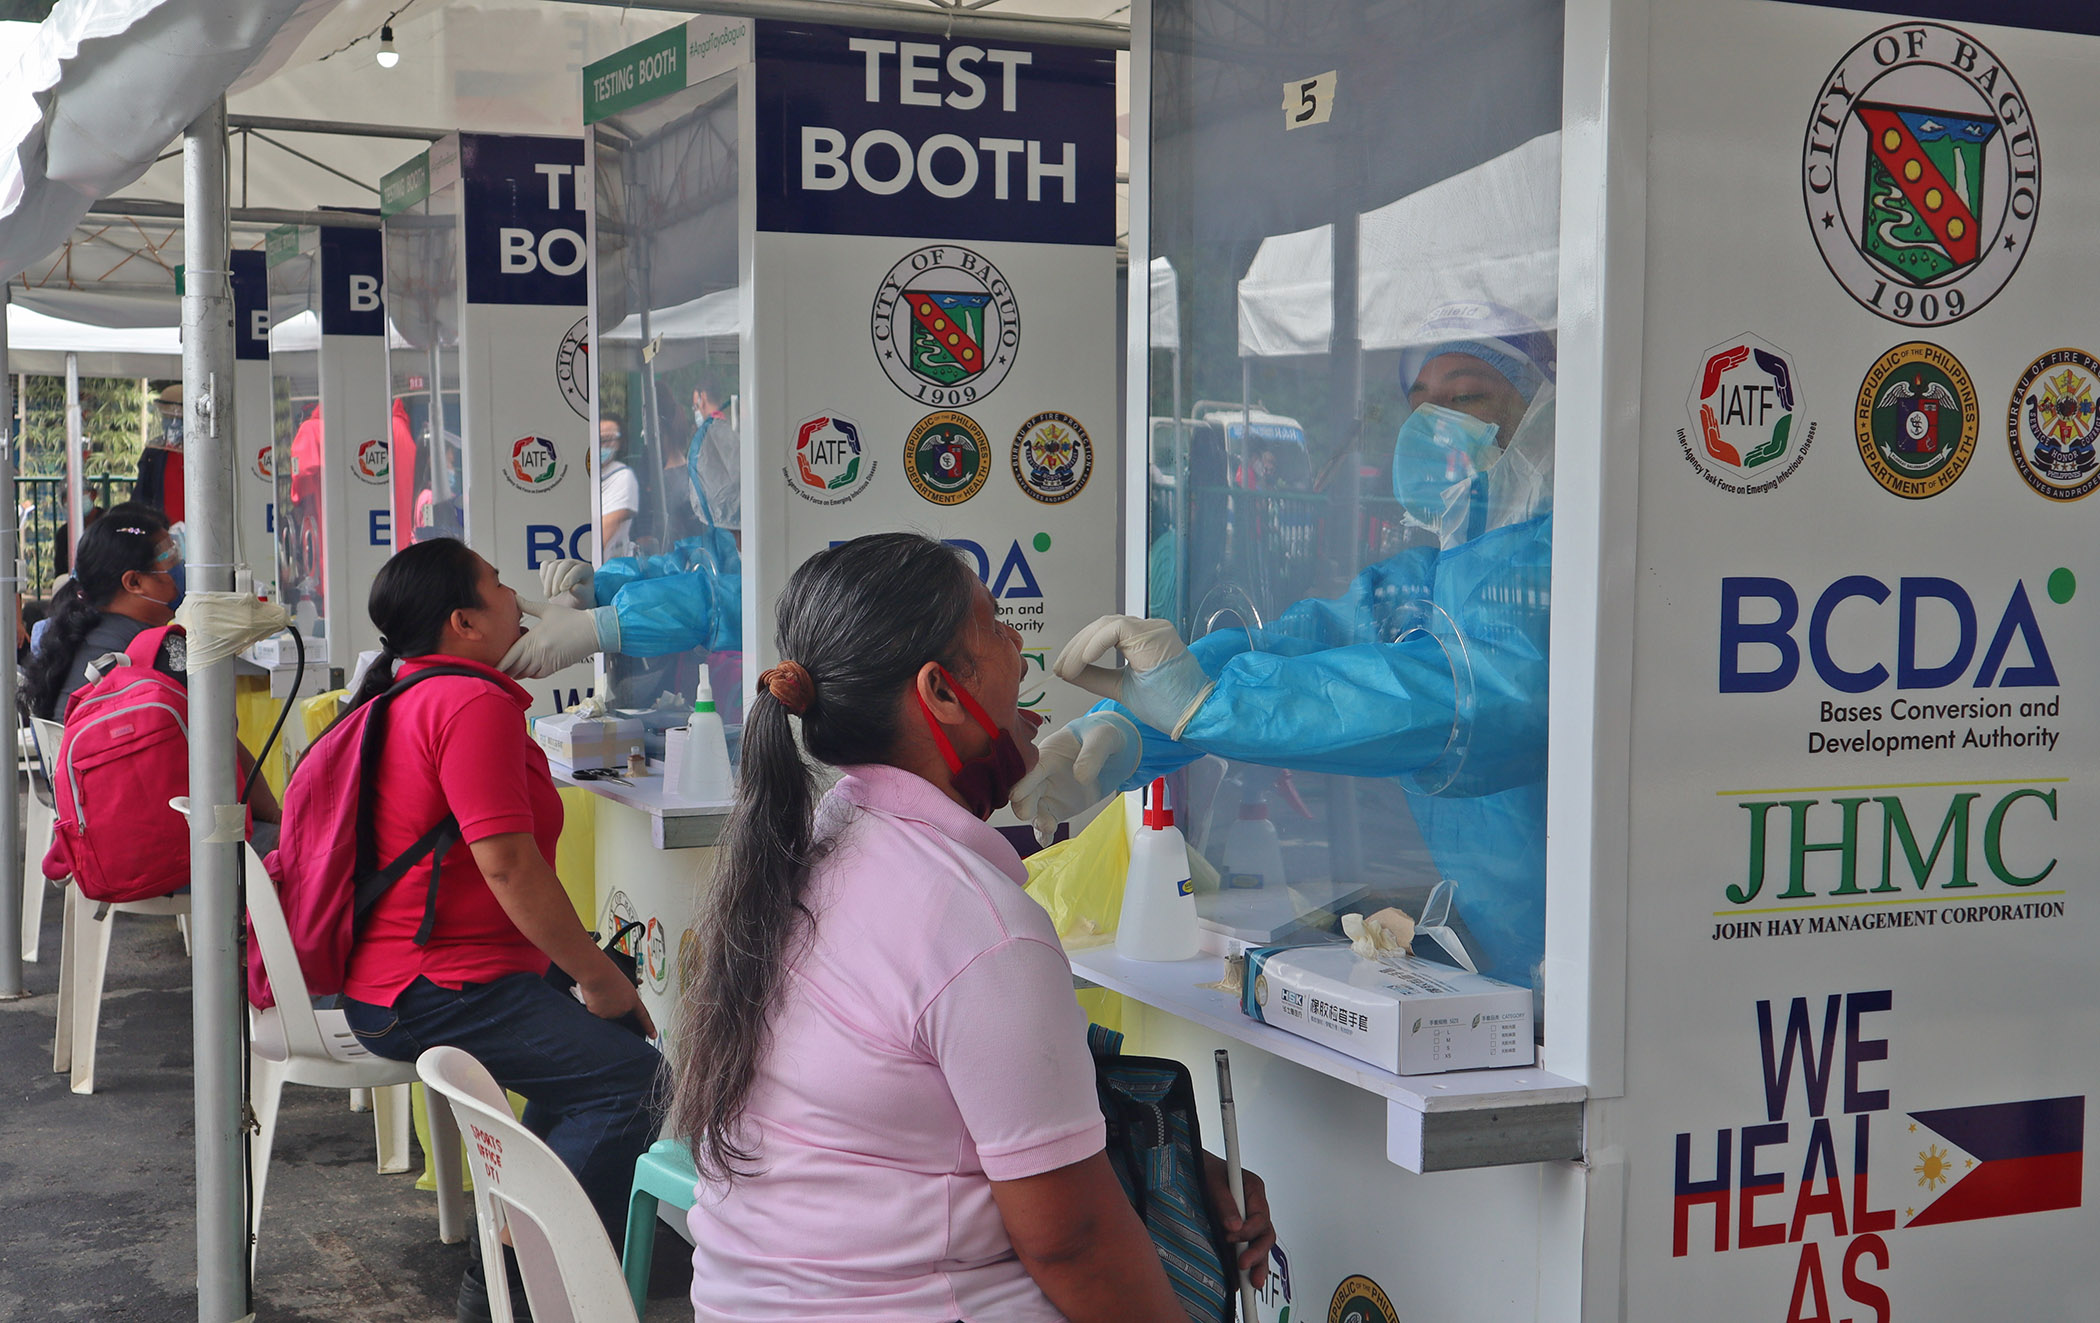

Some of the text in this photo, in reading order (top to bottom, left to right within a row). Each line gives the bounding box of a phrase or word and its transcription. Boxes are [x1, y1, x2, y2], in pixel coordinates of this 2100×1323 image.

[593, 46, 677, 103] TESTING BOOTH
[849, 37, 1032, 112] TEST
[1296, 80, 1317, 122] 5
[1809, 28, 2036, 220] CITY OF BAGUIO
[535, 163, 586, 210] T
[801, 126, 1076, 204] BOOTH
[875, 249, 1017, 347] CITY OF BAGUIO
[1866, 279, 1965, 321] 1909
[560, 331, 578, 381] CITY
[915, 383, 977, 405] 1909
[1720, 384, 1774, 426] IATF
[1859, 352, 1901, 419] REPUBLIC
[1901, 350, 1909, 358] OF
[1924, 348, 1975, 423] PHILIPPINES
[2010, 377, 2030, 437] BUREAU
[2032, 359, 2045, 374] OF
[2051, 352, 2078, 364] FIRE
[366, 451, 387, 465] IATF
[521, 451, 547, 468] IATF
[811, 440, 847, 465] IATF
[906, 417, 934, 458] REPUBLIC
[950, 414, 988, 459] PHILIPPINES
[1012, 430, 1026, 467] BUREAU
[1027, 420, 1036, 429] OF
[1040, 413, 1060, 421] FIRE
[1063, 416, 1092, 467] PROTECTION
[1676, 421, 1818, 494] Inter-Agency Task Force on Emerging Infectious Diseases
[2052, 450, 2078, 462] HONOR
[908, 466, 956, 502] DEPARTMENT
[963, 465, 987, 497] HEALTH
[1860, 432, 1973, 494] DEPARTMENT OF HEALTH
[2014, 450, 2029, 474] SAVE
[2028, 475, 2051, 494] LIVES
[1018, 602, 1043, 615] and
[1719, 575, 2060, 694] BCDA
[1820, 695, 2060, 722] Bases Conversion and
[1808, 725, 2060, 756] Development Authority
[1725, 788, 2057, 904] JHMC
[1712, 901, 2065, 941] JOHN HAY MANAGEMENT CORPORATION
[1281, 988, 1303, 1006] HSK
[1756, 990, 1892, 1121] WE
[470, 1123, 503, 1154] SPORTS
[1673, 1114, 1896, 1257] HEAL
[1786, 1233, 1890, 1323] AS
